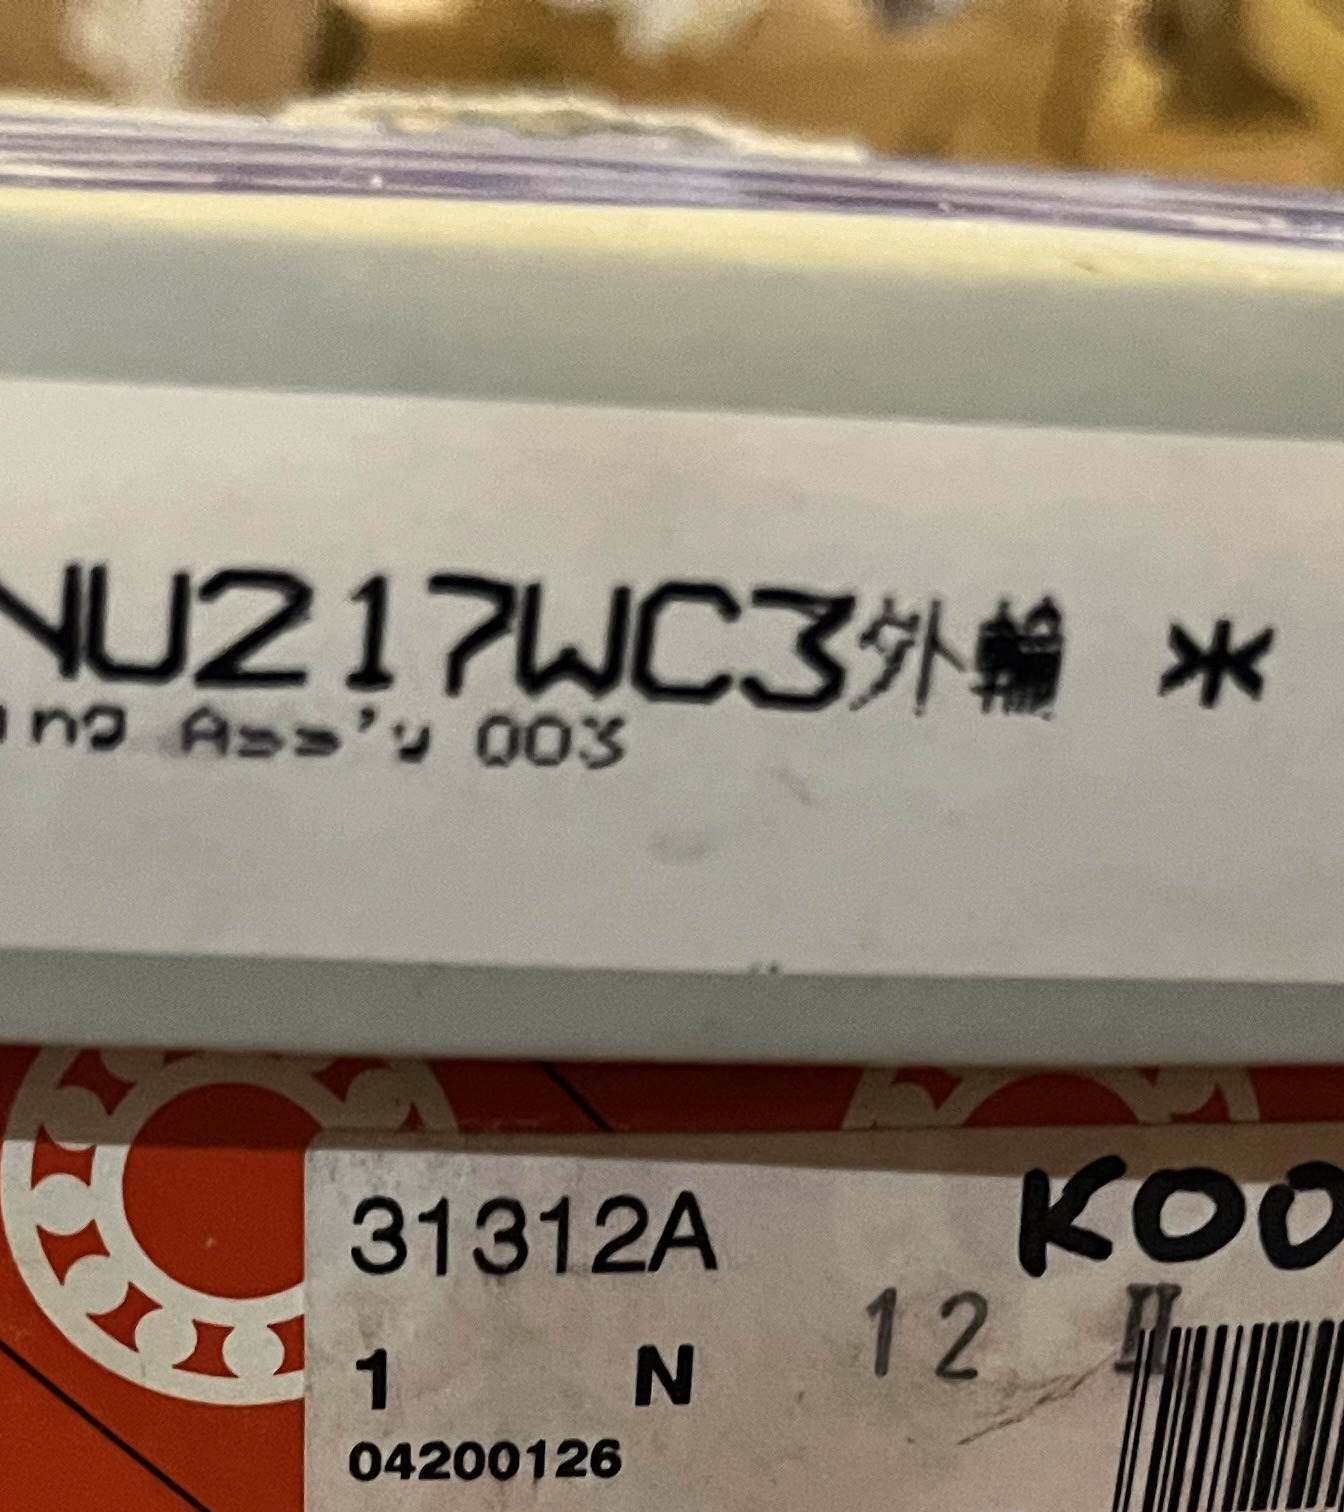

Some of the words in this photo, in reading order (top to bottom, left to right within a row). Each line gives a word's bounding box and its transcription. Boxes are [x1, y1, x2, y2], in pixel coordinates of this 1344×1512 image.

[475, 713, 626, 770] 003
[350, 1190, 718, 1275] 31312A
[356, 1348, 388, 1410] 1
[634, 1344, 694, 1407] N
[348, 1439, 622, 1481] 04200126
